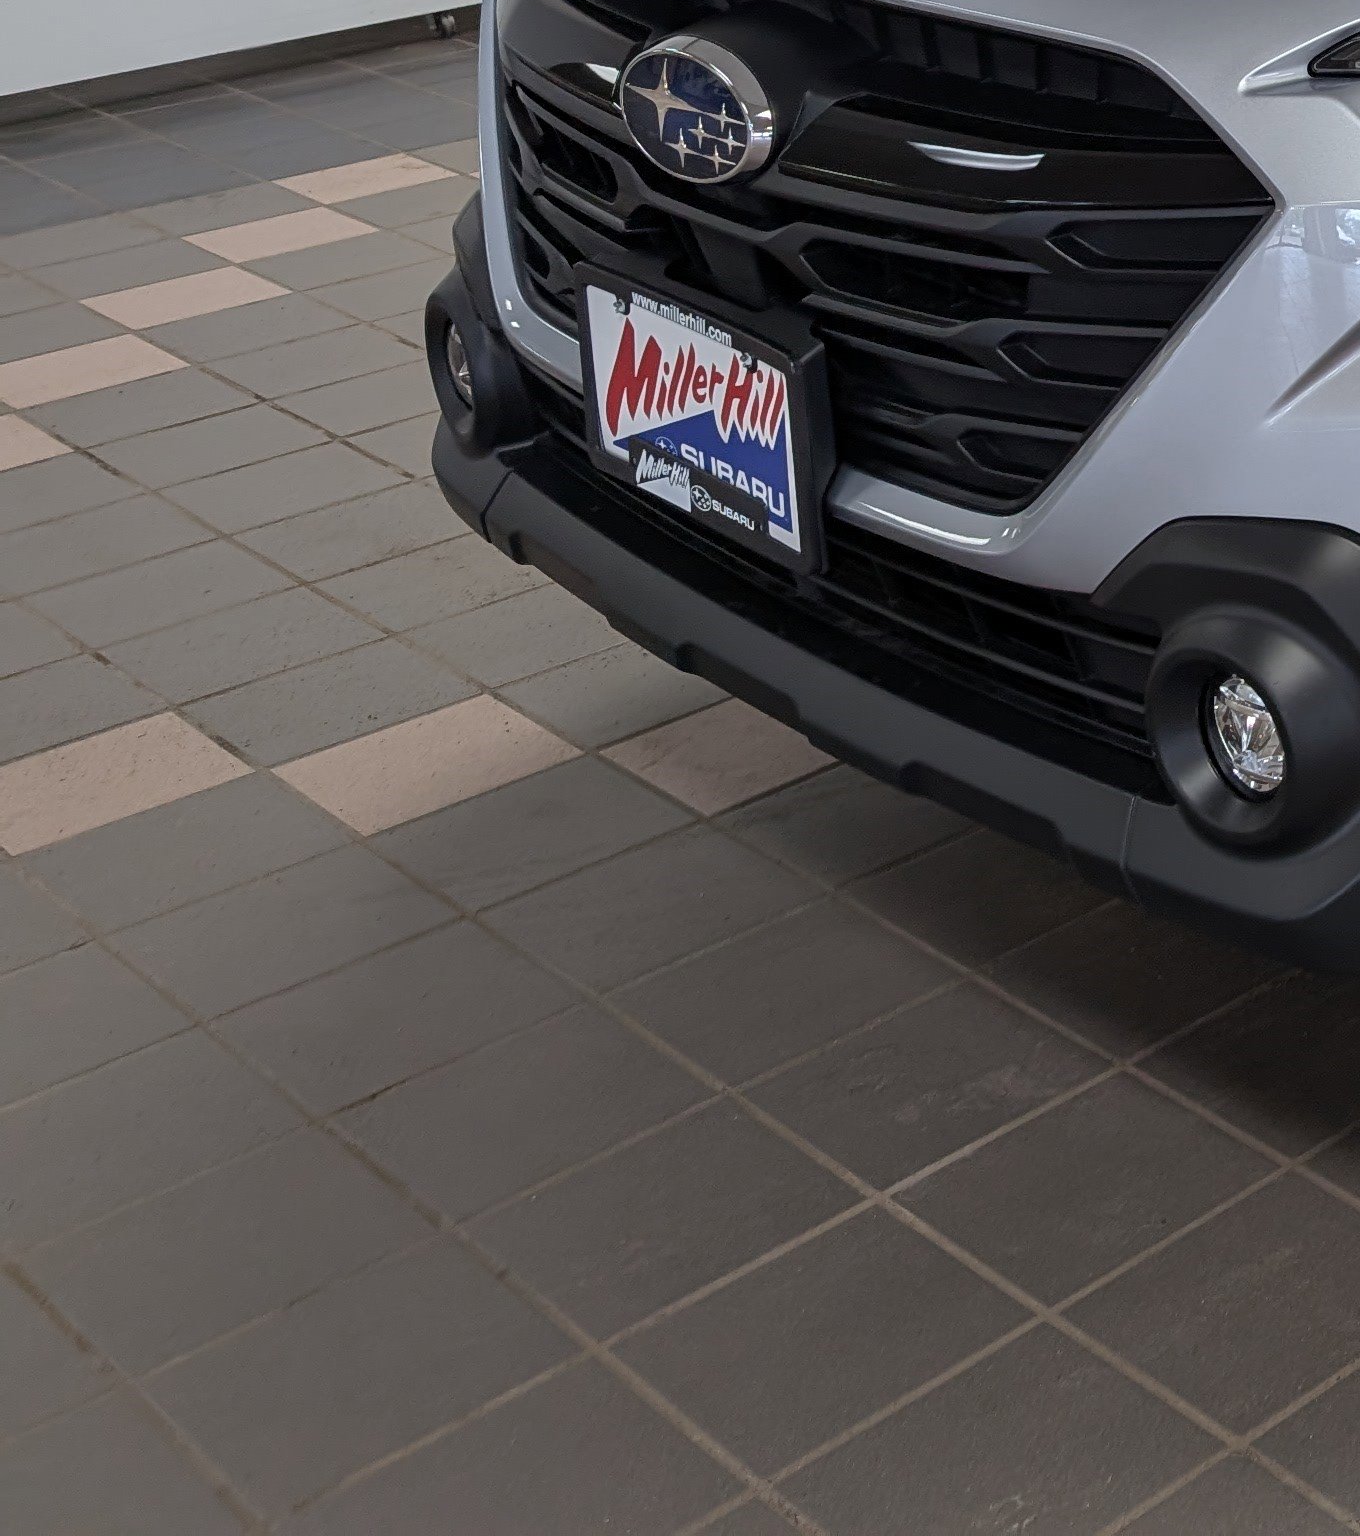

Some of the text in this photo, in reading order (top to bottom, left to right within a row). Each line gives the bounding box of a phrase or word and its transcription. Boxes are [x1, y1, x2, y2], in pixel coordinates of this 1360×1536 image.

[631, 291, 733, 348] www.millerhill.com
[605, 317, 785, 441] Miller Hill
[635, 449, 672, 484] Miller
[712, 499, 755, 531] SUBARU
